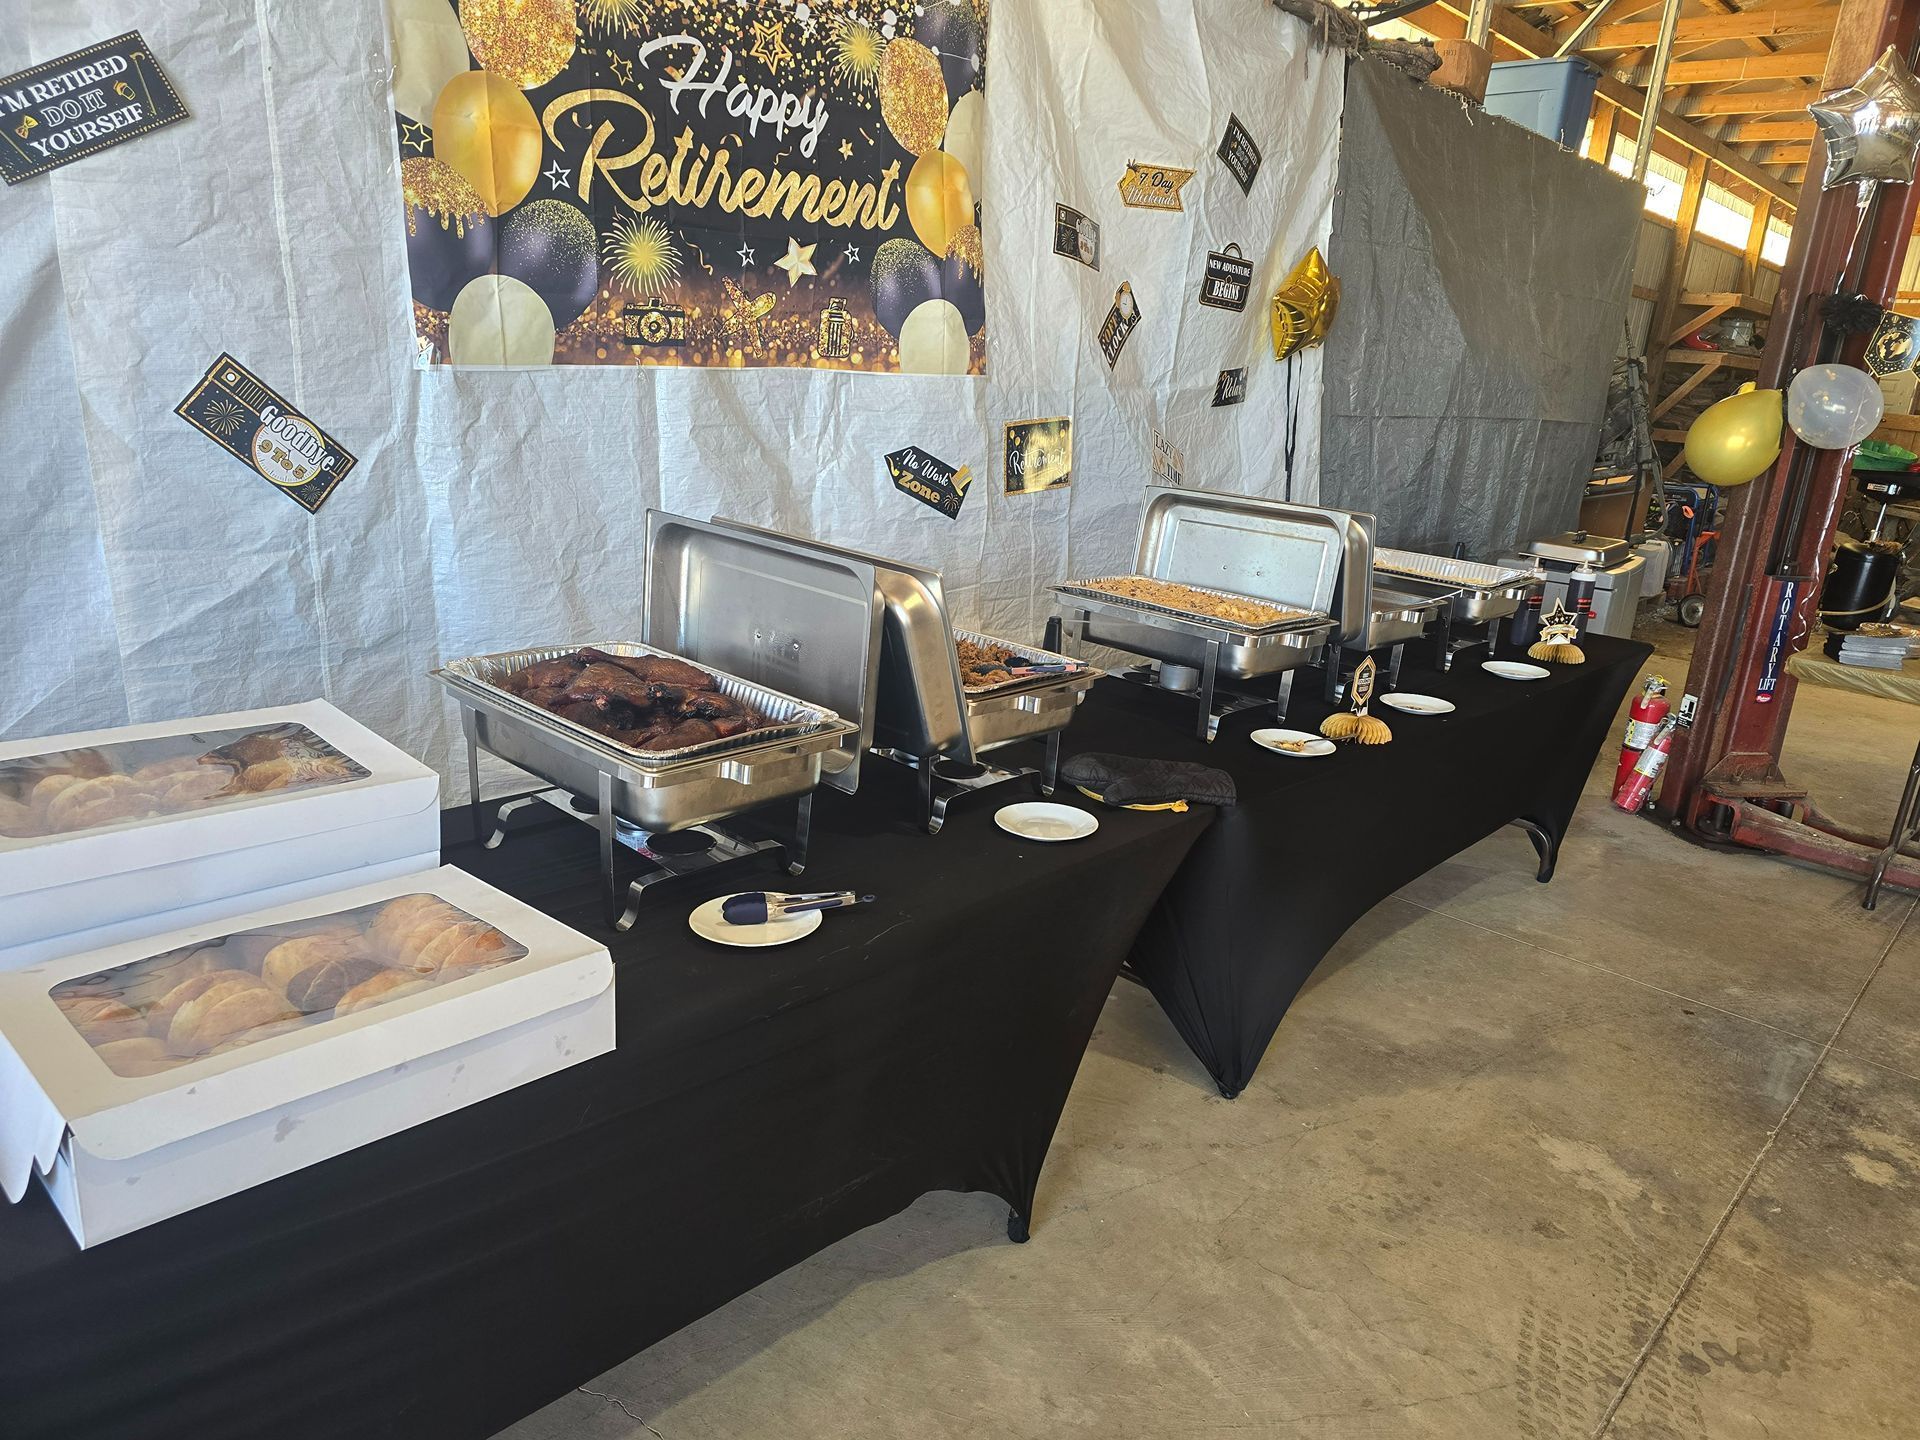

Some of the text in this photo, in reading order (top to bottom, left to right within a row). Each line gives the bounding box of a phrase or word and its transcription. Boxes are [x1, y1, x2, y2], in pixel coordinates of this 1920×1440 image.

[0, 55, 128, 118] 'M RETIRED
[638, 34, 829, 158] Happy
[40, 88, 107, 127] DO IT
[542, 88, 900, 231] Retirement
[1127, 185, 1175, 206] Weekends
[1140, 172, 1174, 194] 7 Day
[1209, 259, 1251, 277] NEW ADVENTURE
[1212, 281, 1240, 300] BEGINS
[1106, 320, 1128, 364] CLOCK
[259, 405, 336, 472] Goodbye
[1155, 434, 1174, 460] LAZY
[259, 439, 274, 453] 9
[292, 464, 308, 479] 5
[902, 448, 949, 487] No Work
[1009, 448, 1066, 475] Retirement
[898, 470, 941, 503] Zone
[1765, 581, 1794, 680] ROTARY
[1757, 678, 1776, 691] LIFT
